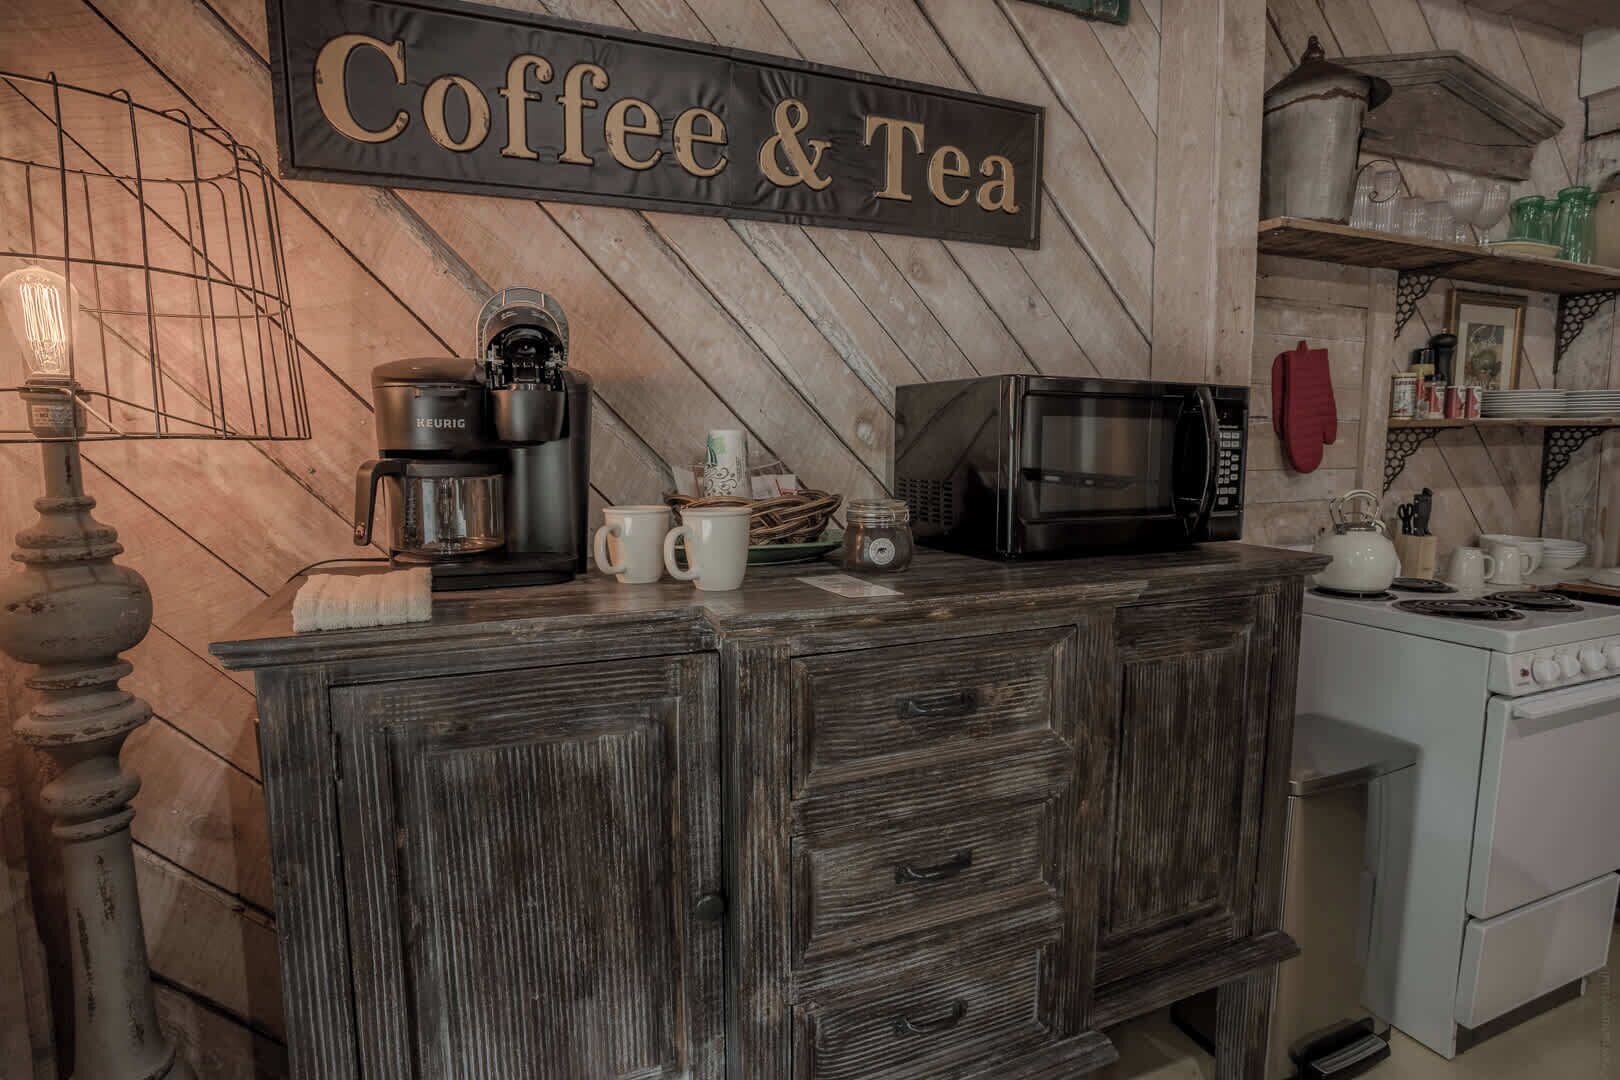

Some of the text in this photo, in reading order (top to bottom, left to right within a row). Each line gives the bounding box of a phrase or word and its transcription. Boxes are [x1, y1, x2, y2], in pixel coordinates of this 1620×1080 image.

[315, 33, 1019, 213] Coffee & Tea
[416, 418, 465, 428] KEURIG
